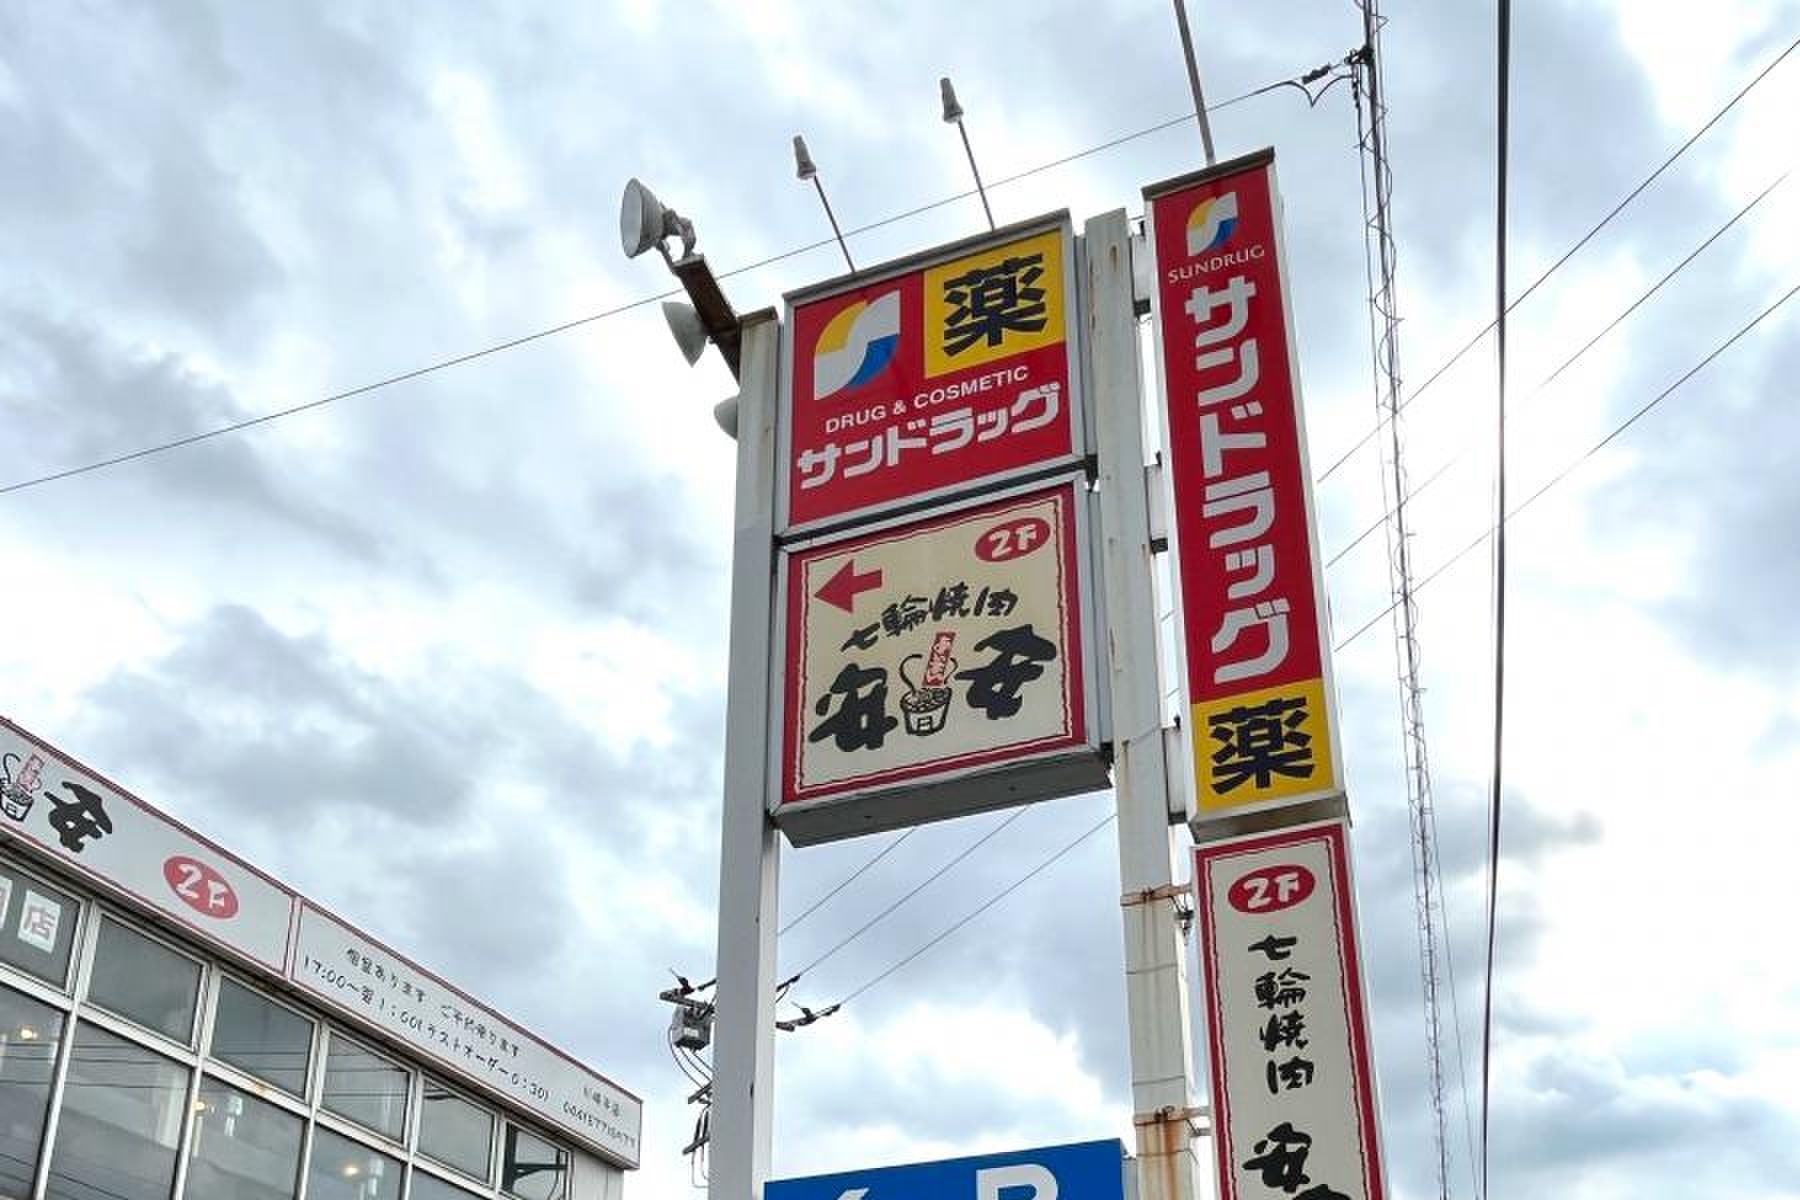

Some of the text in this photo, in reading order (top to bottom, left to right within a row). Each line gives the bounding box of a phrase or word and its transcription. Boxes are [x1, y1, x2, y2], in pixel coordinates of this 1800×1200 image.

[1168, 245, 1265, 284] SUNDRUG
[943, 252, 1047, 357] 薬
[797, 381, 1061, 490] サンドラッグ
[825, 365, 1029, 434] DRUG & COSMETIC
[1185, 275, 1291, 685] サンドラッグ
[988, 523, 1038, 560] 2F
[840, 581, 1019, 653] 七輪焼肉
[1207, 696, 1315, 795] 薬
[175, 862, 227, 911] 2F
[1243, 874, 1301, 908] 2F
[1247, 935, 1315, 1094] 七輪焼肉
